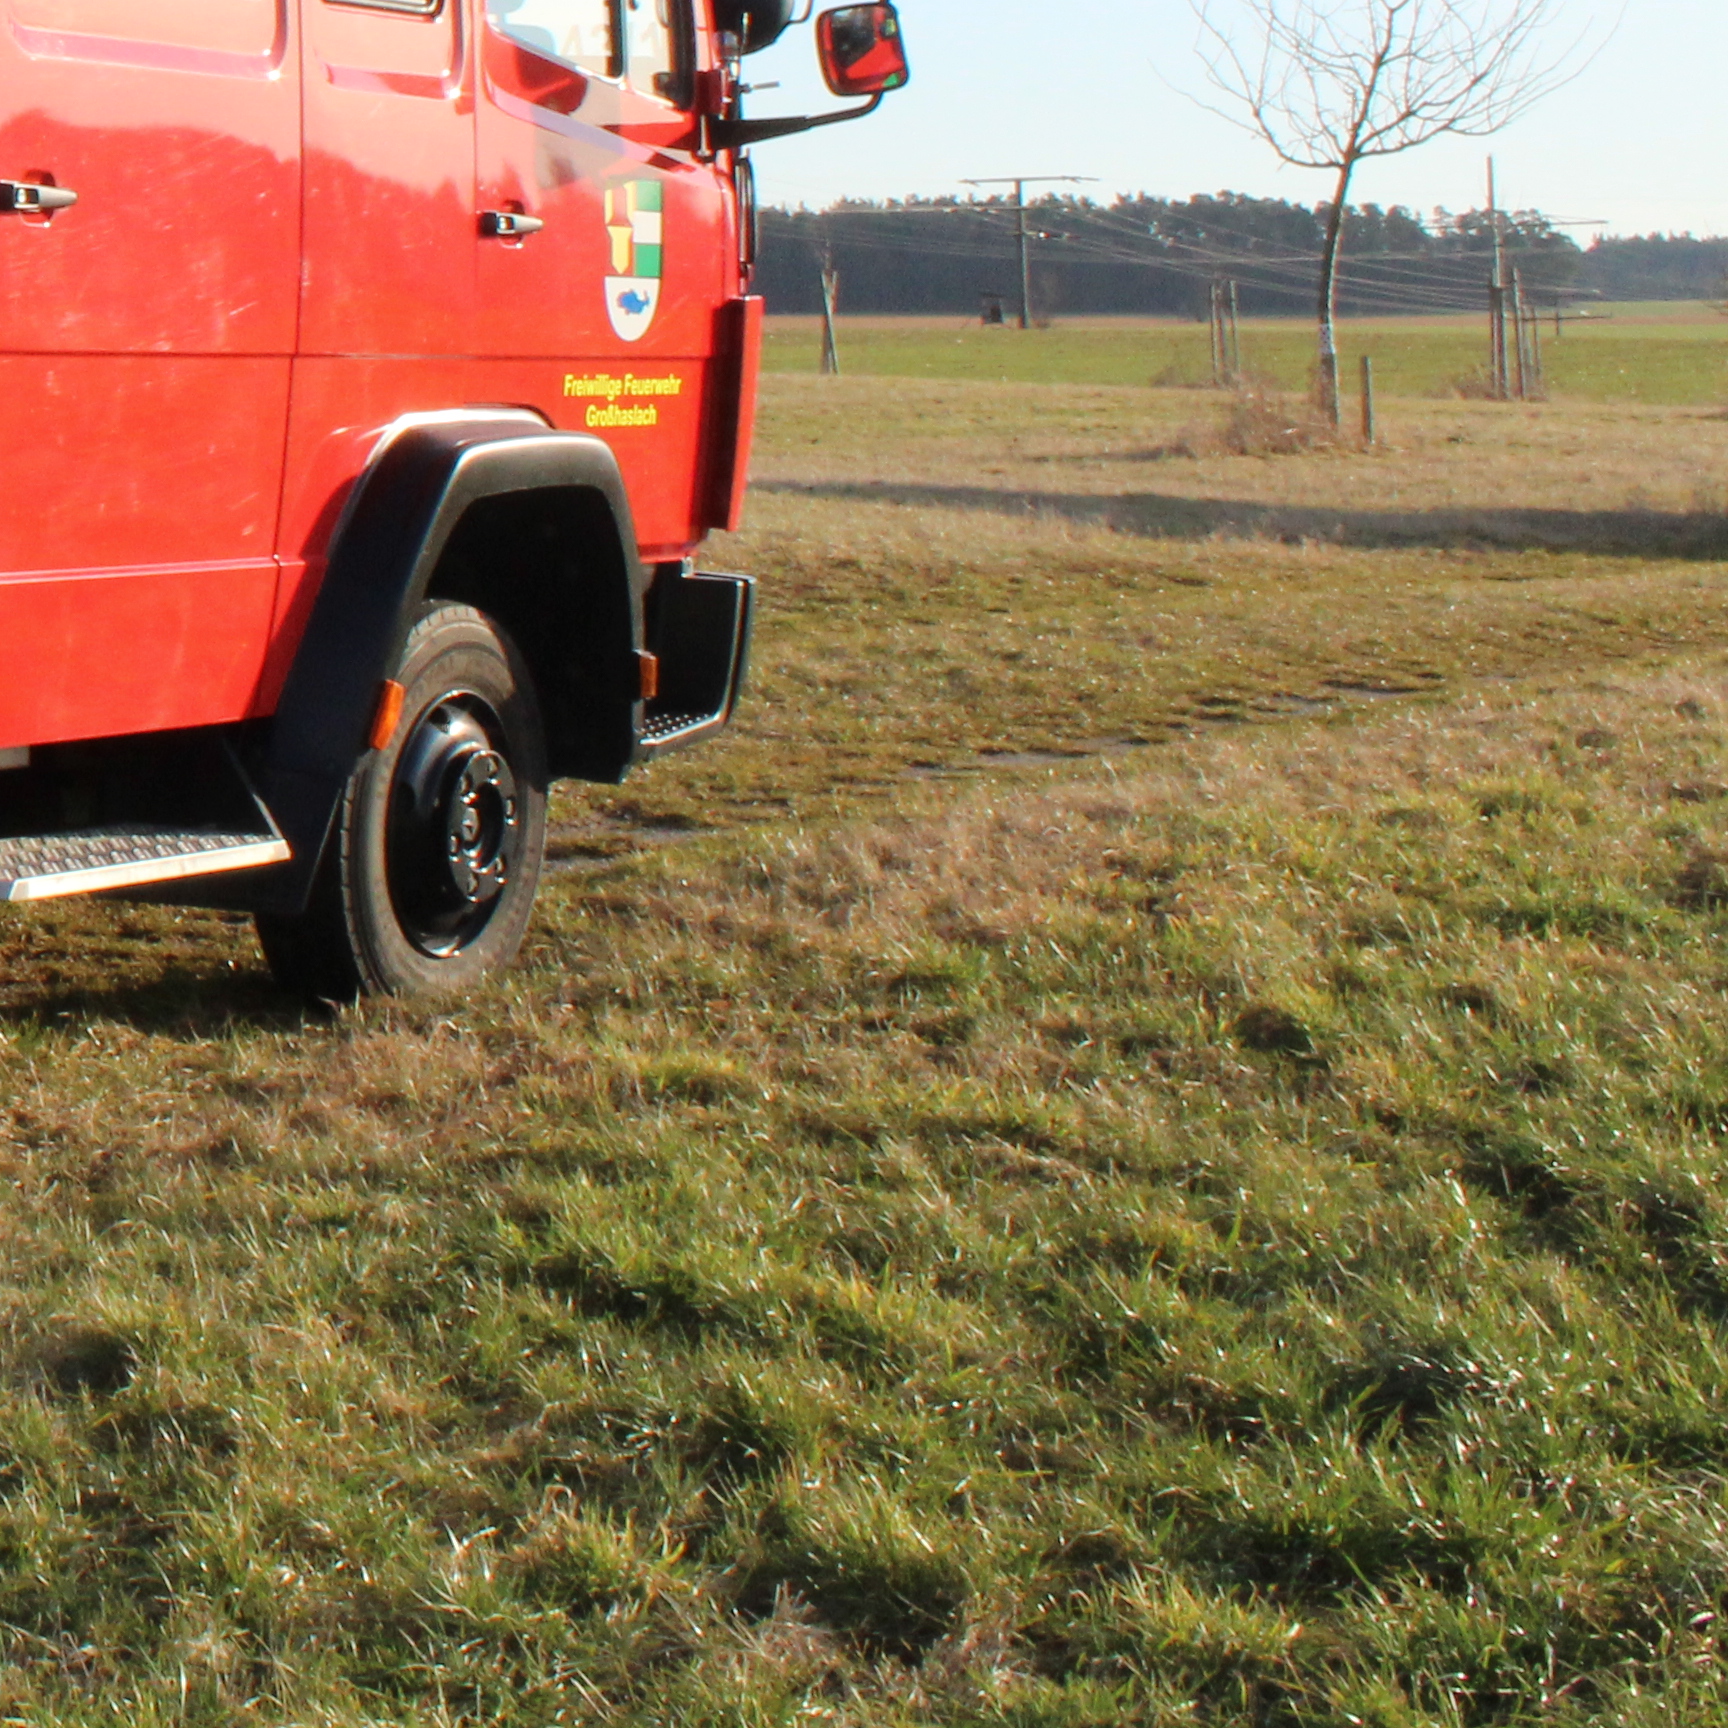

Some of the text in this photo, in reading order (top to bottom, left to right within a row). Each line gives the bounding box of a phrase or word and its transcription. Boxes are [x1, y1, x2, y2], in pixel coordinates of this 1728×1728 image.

[563, 373, 682, 401] Freiwillige Feuerwehr
[585, 404, 657, 427] Großhaslach
